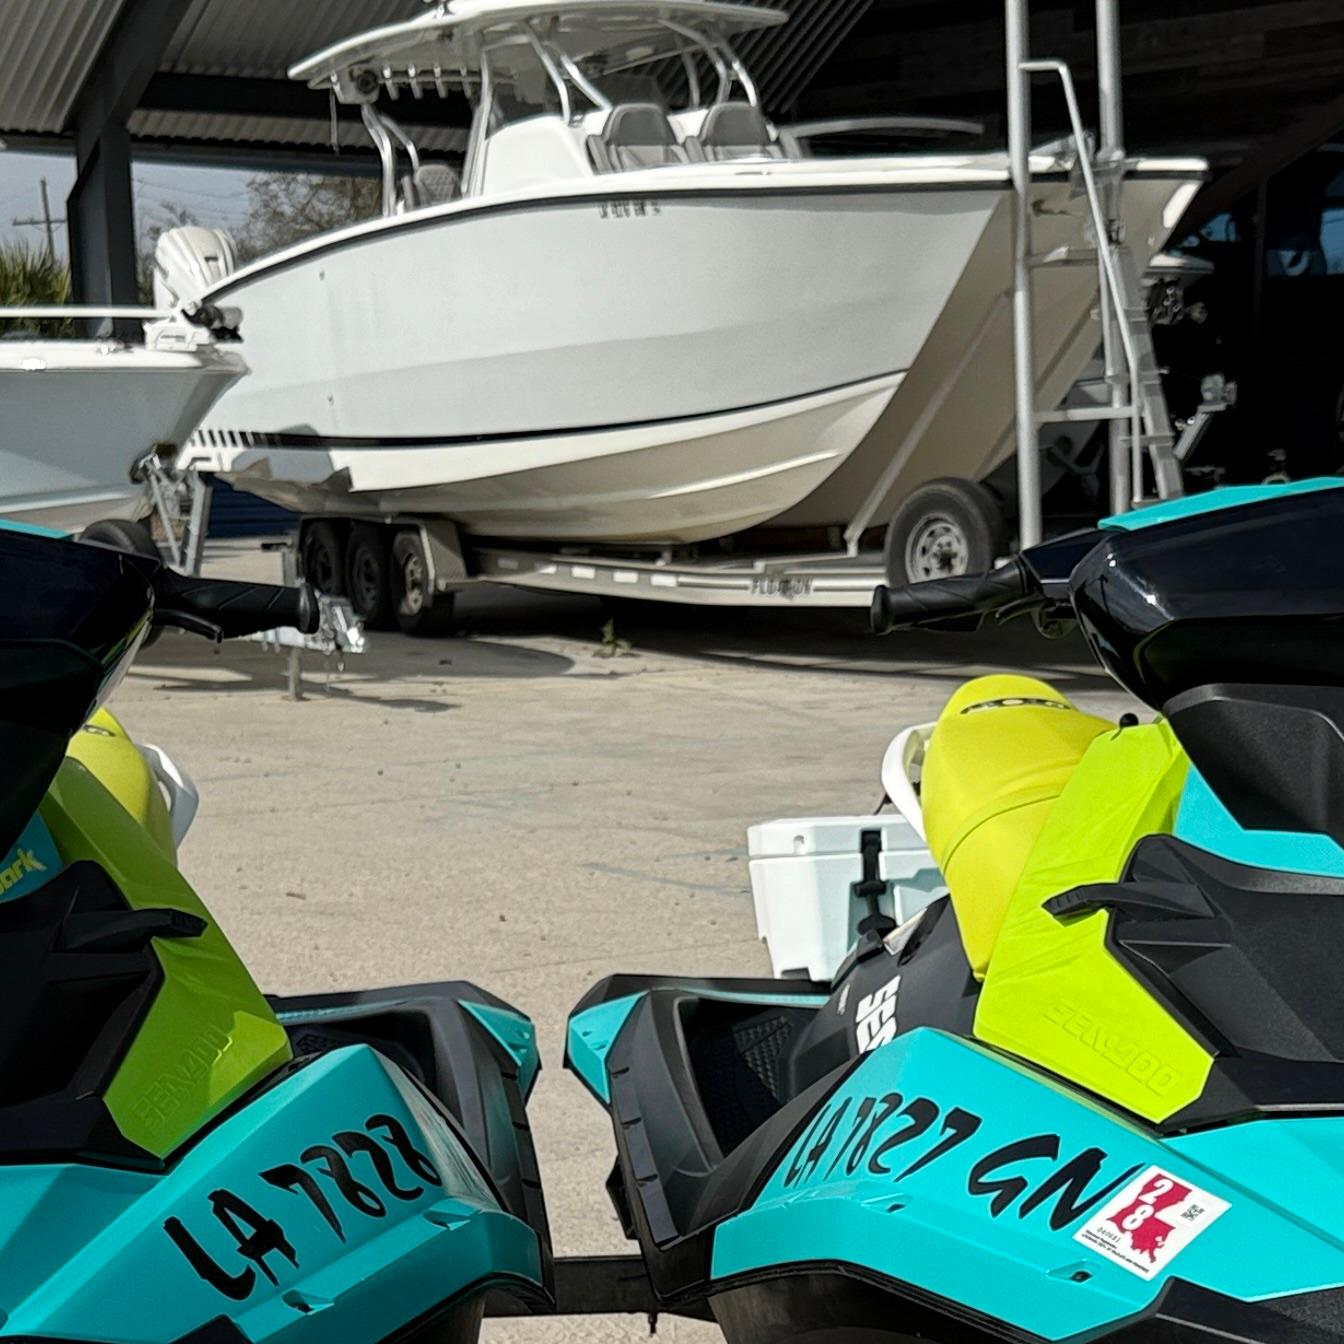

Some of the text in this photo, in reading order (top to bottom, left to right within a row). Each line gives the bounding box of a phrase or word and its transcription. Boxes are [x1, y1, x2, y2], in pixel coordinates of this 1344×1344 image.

[162, 1113, 443, 1300] LA 7828
[783, 1092, 1146, 1231] LA 7827 GN
